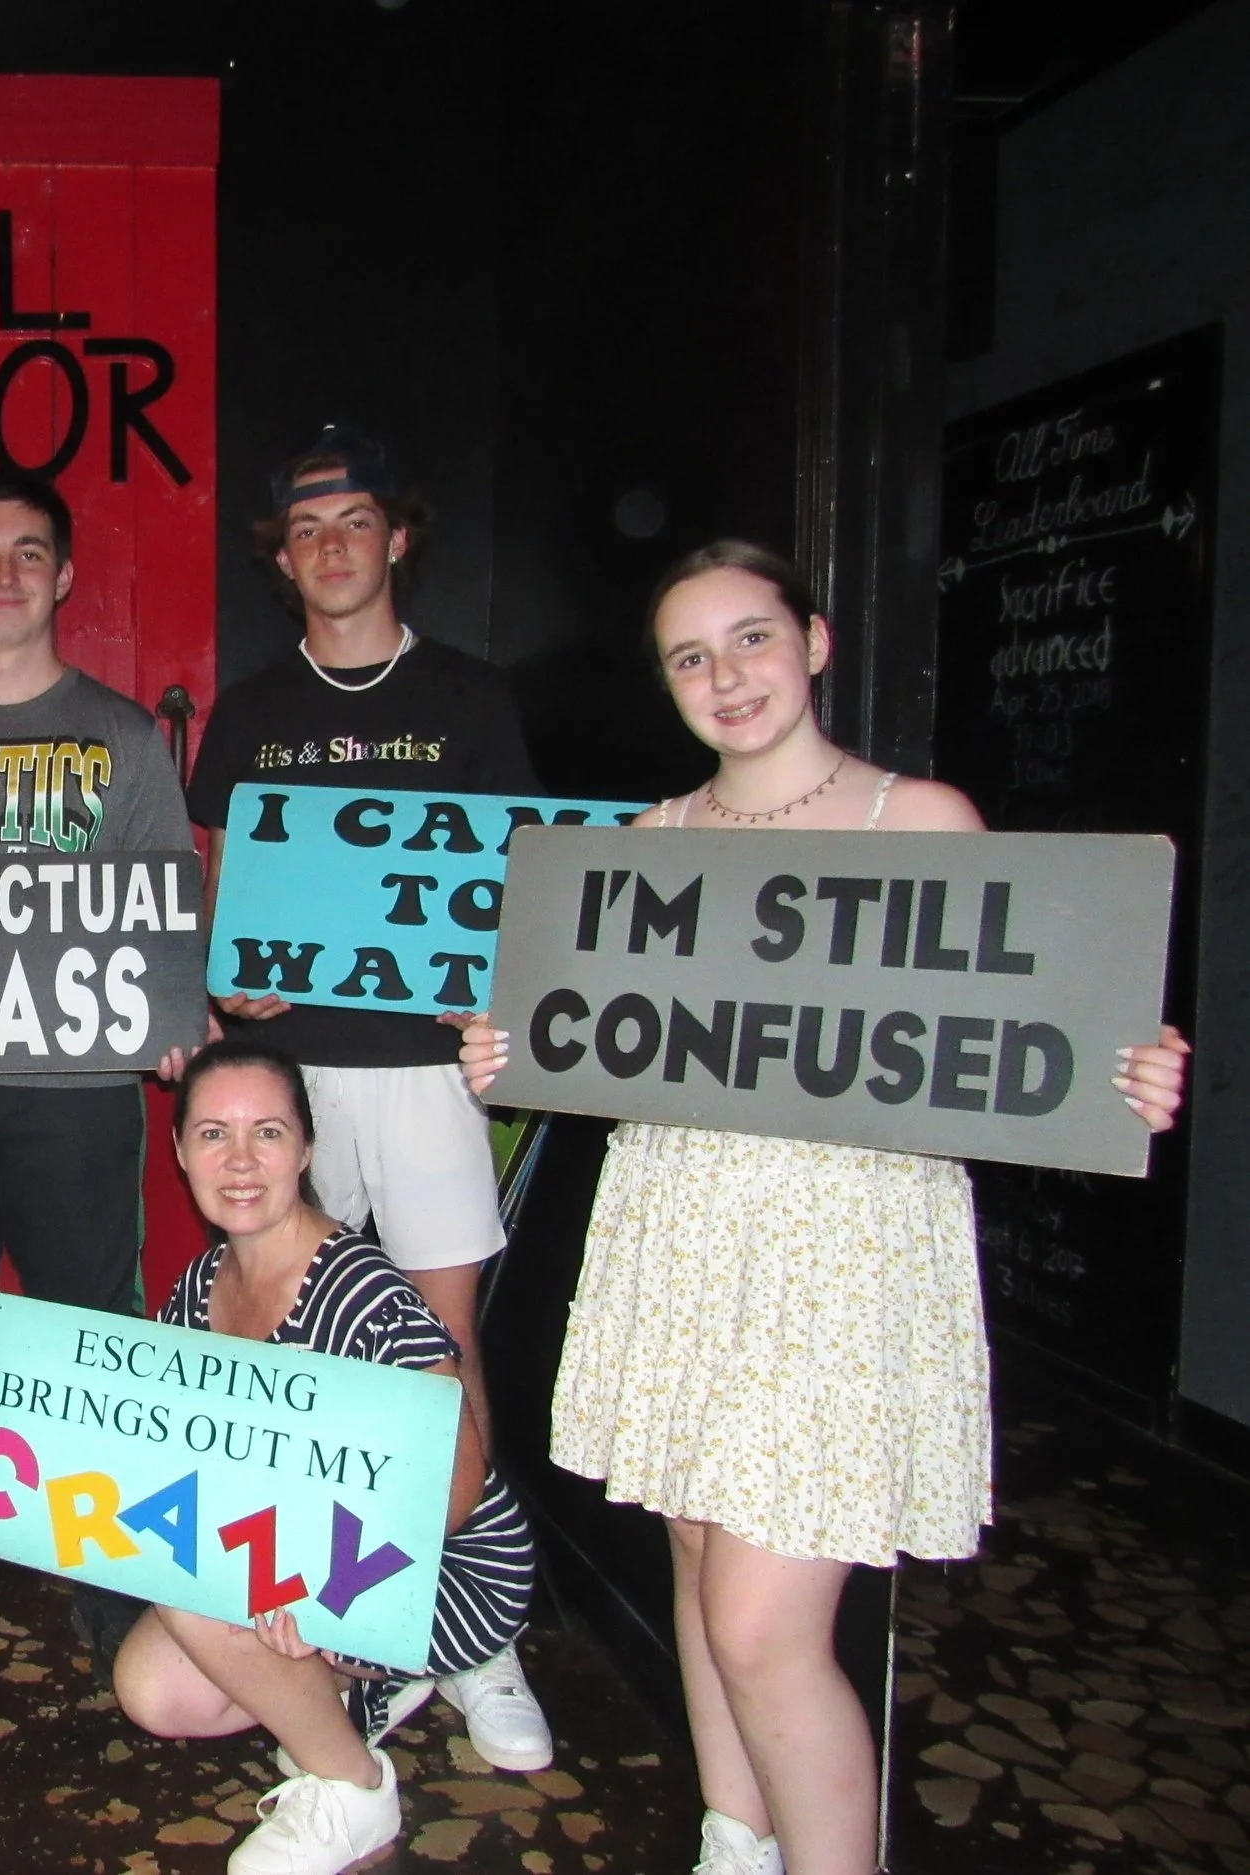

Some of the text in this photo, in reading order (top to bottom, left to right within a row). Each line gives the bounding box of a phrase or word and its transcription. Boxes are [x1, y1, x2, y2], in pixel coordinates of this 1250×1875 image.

[249, 793, 290, 843] I
[380, 873, 504, 931] TO
[576, 870, 1036, 976] I'M STILL
[529, 988, 1075, 1117] CONFUSED
[74, 1329, 318, 1413] ESCAPING
[0, 1372, 393, 1491] BRINGS OUT MY
